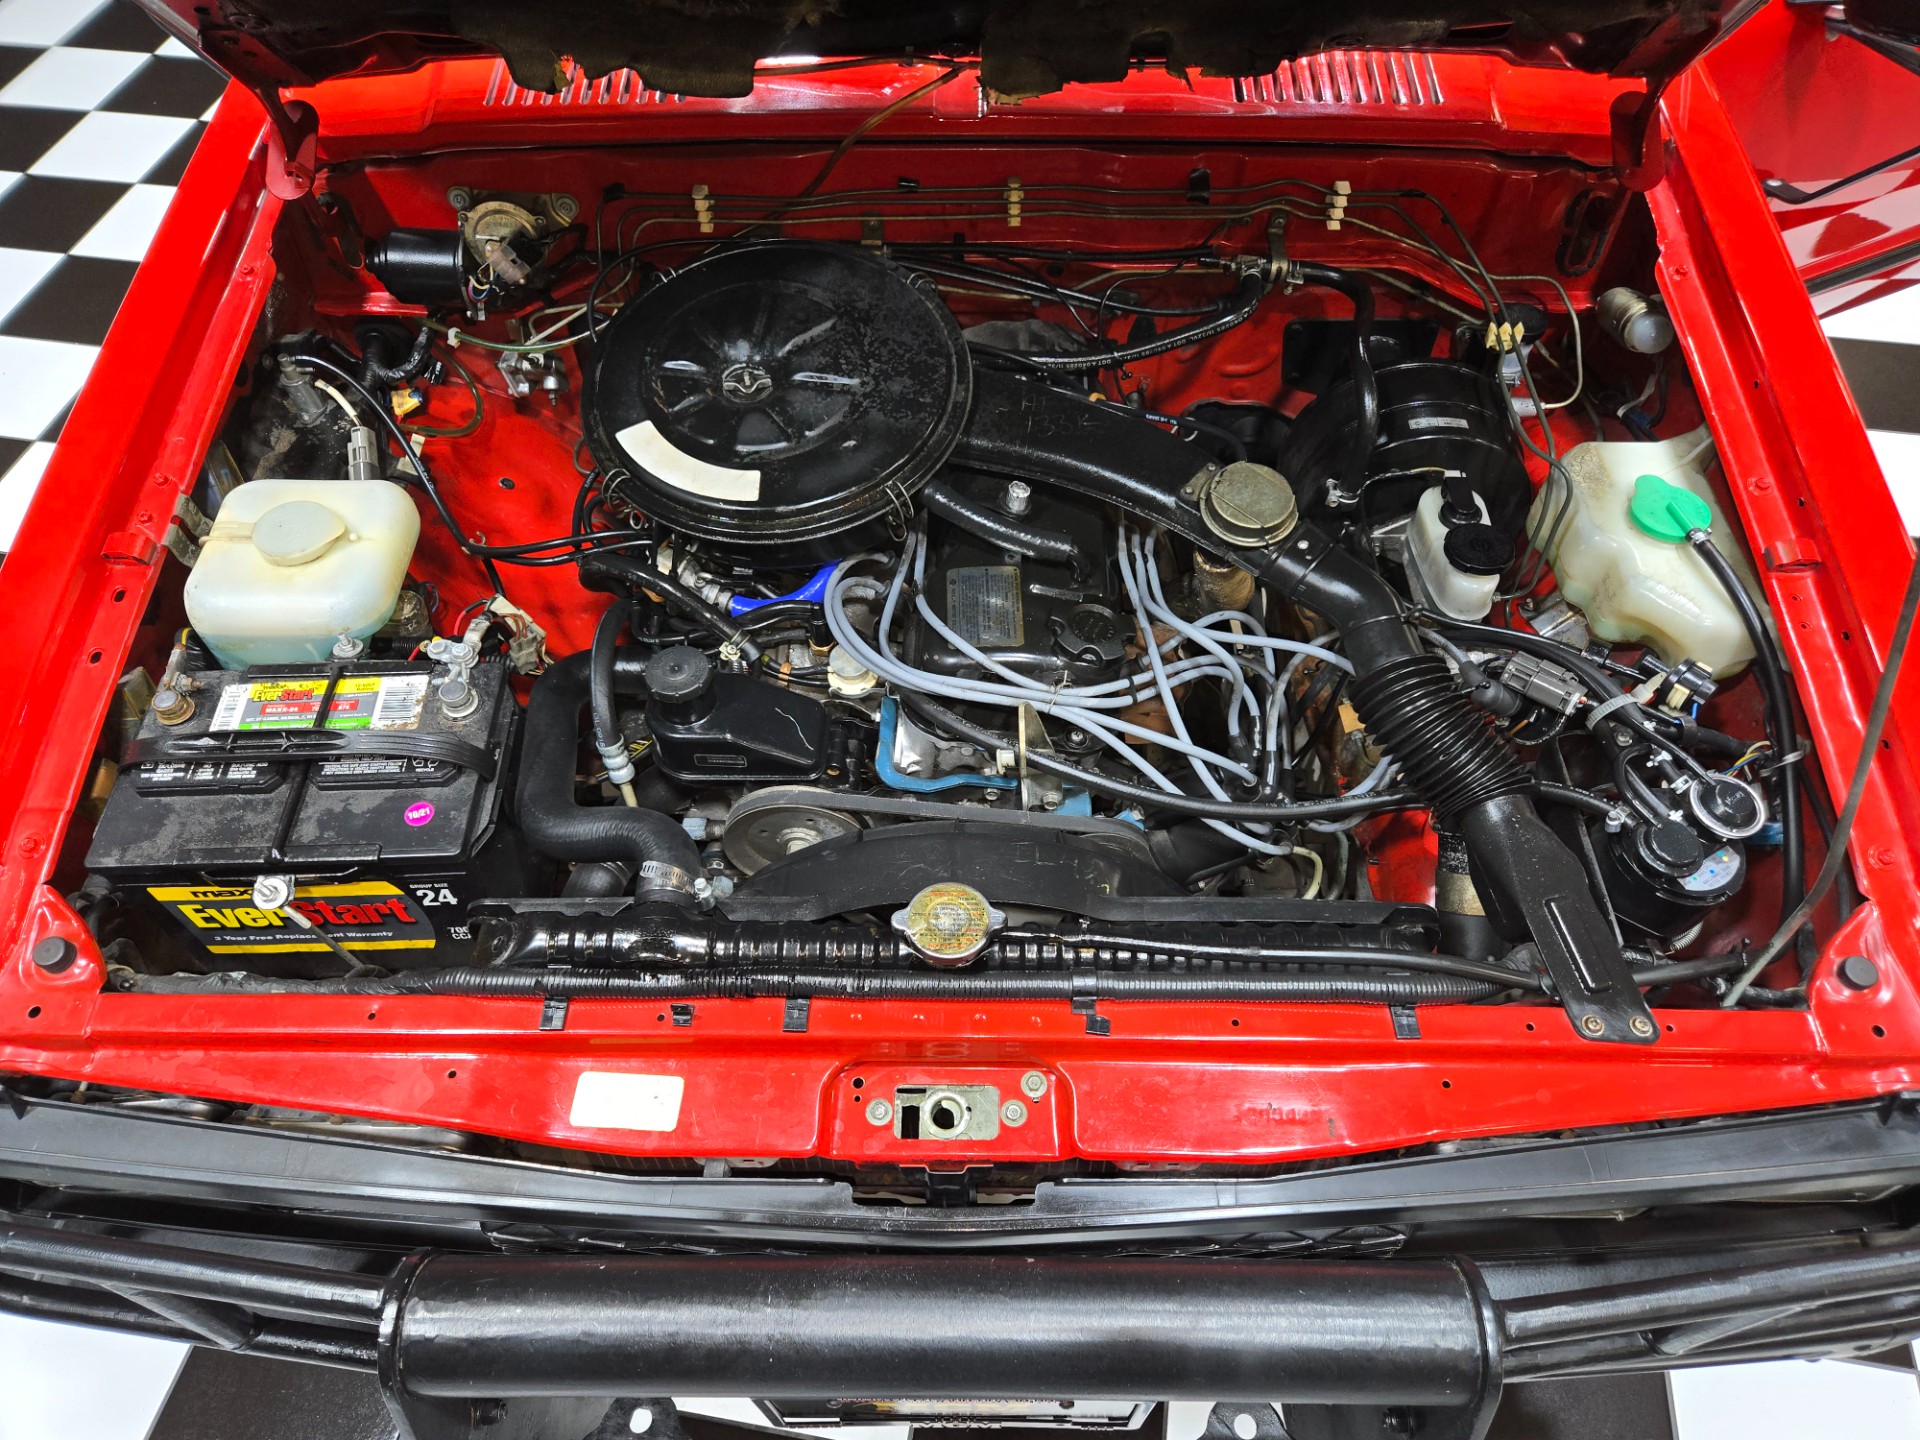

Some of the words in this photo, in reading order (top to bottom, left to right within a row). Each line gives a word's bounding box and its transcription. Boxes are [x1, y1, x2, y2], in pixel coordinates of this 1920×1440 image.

[1098, 358, 1112, 366] DOT
[252, 689, 314, 702] EverStart
[407, 807, 432, 821] 10/21
[416, 889, 459, 906] 24
[176, 898, 417, 928] EverStart
[275, 932, 345, 940] Replaceent
